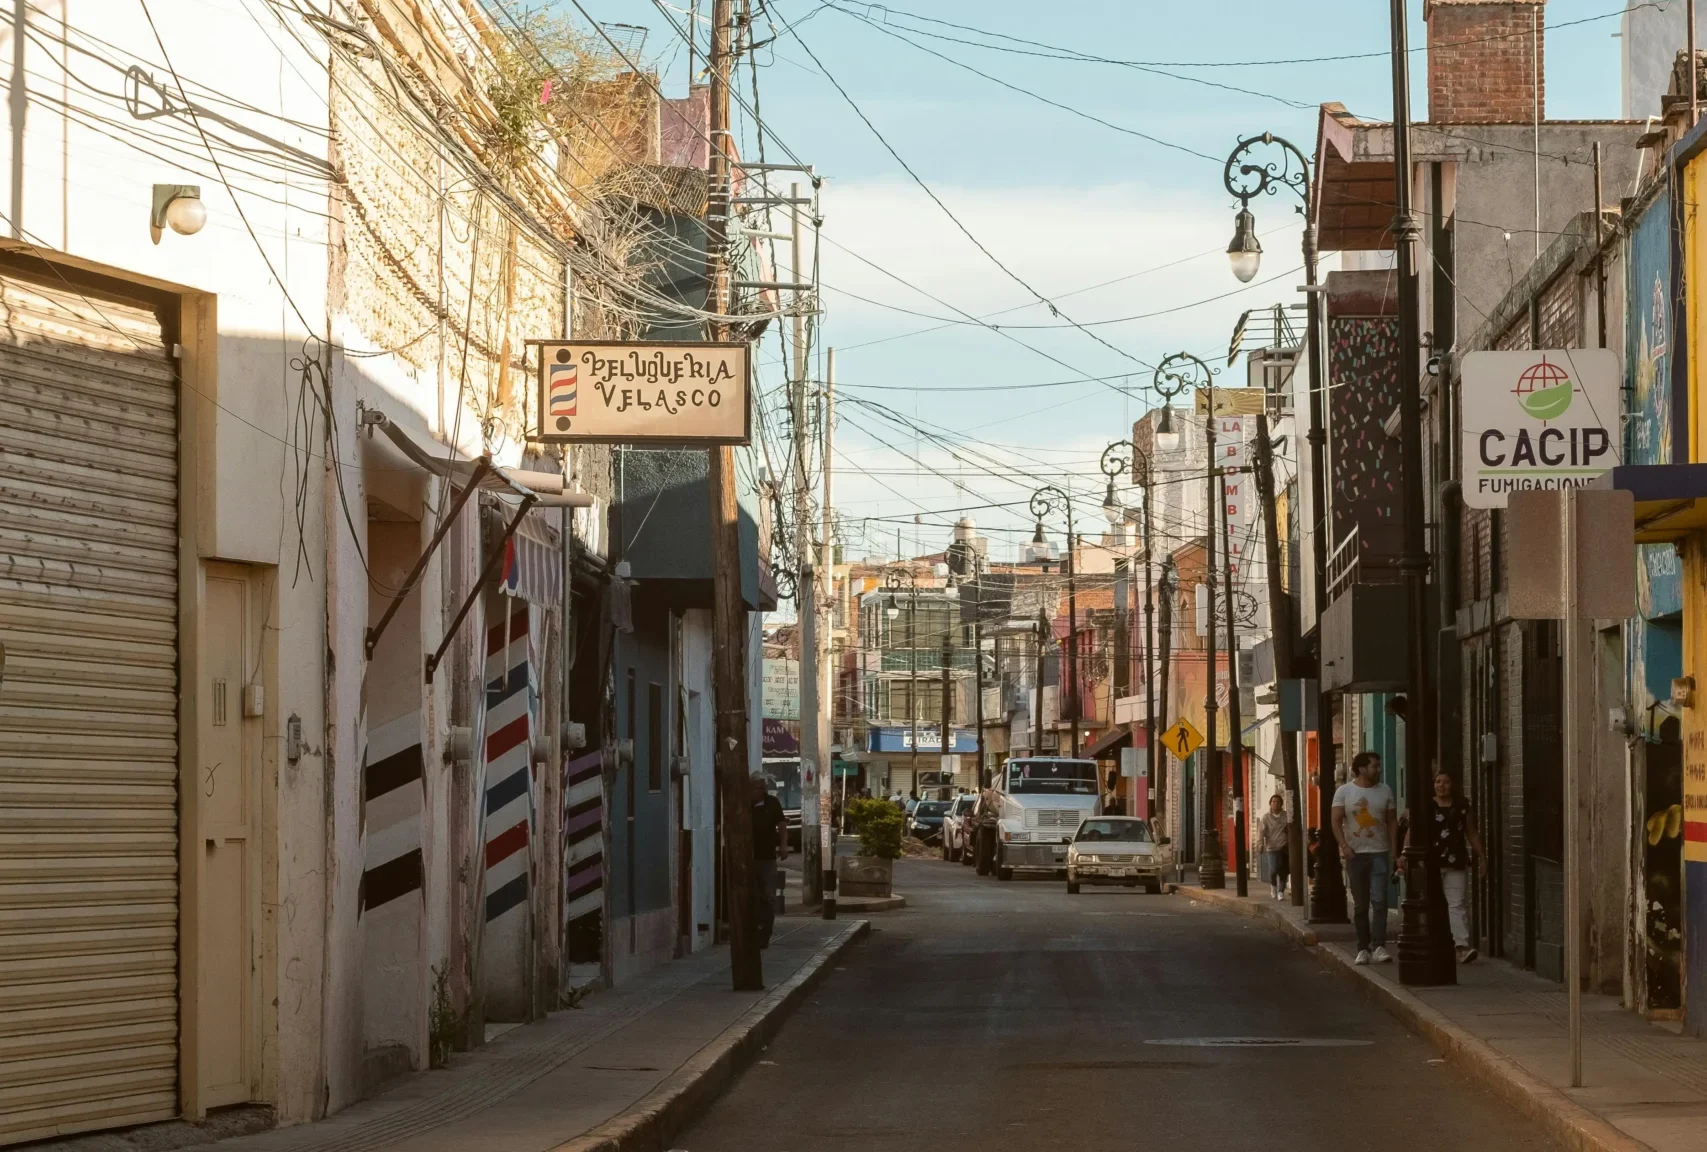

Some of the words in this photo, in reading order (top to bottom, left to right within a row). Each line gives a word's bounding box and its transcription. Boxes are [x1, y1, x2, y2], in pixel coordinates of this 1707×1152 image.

[581, 350, 736, 384] PELUQUERIA
[594, 381, 722, 415] VELASCO
[1222, 421, 1242, 433] LA
[1479, 427, 1609, 468] CACIP
[1224, 445, 1242, 575] BOMBILA
